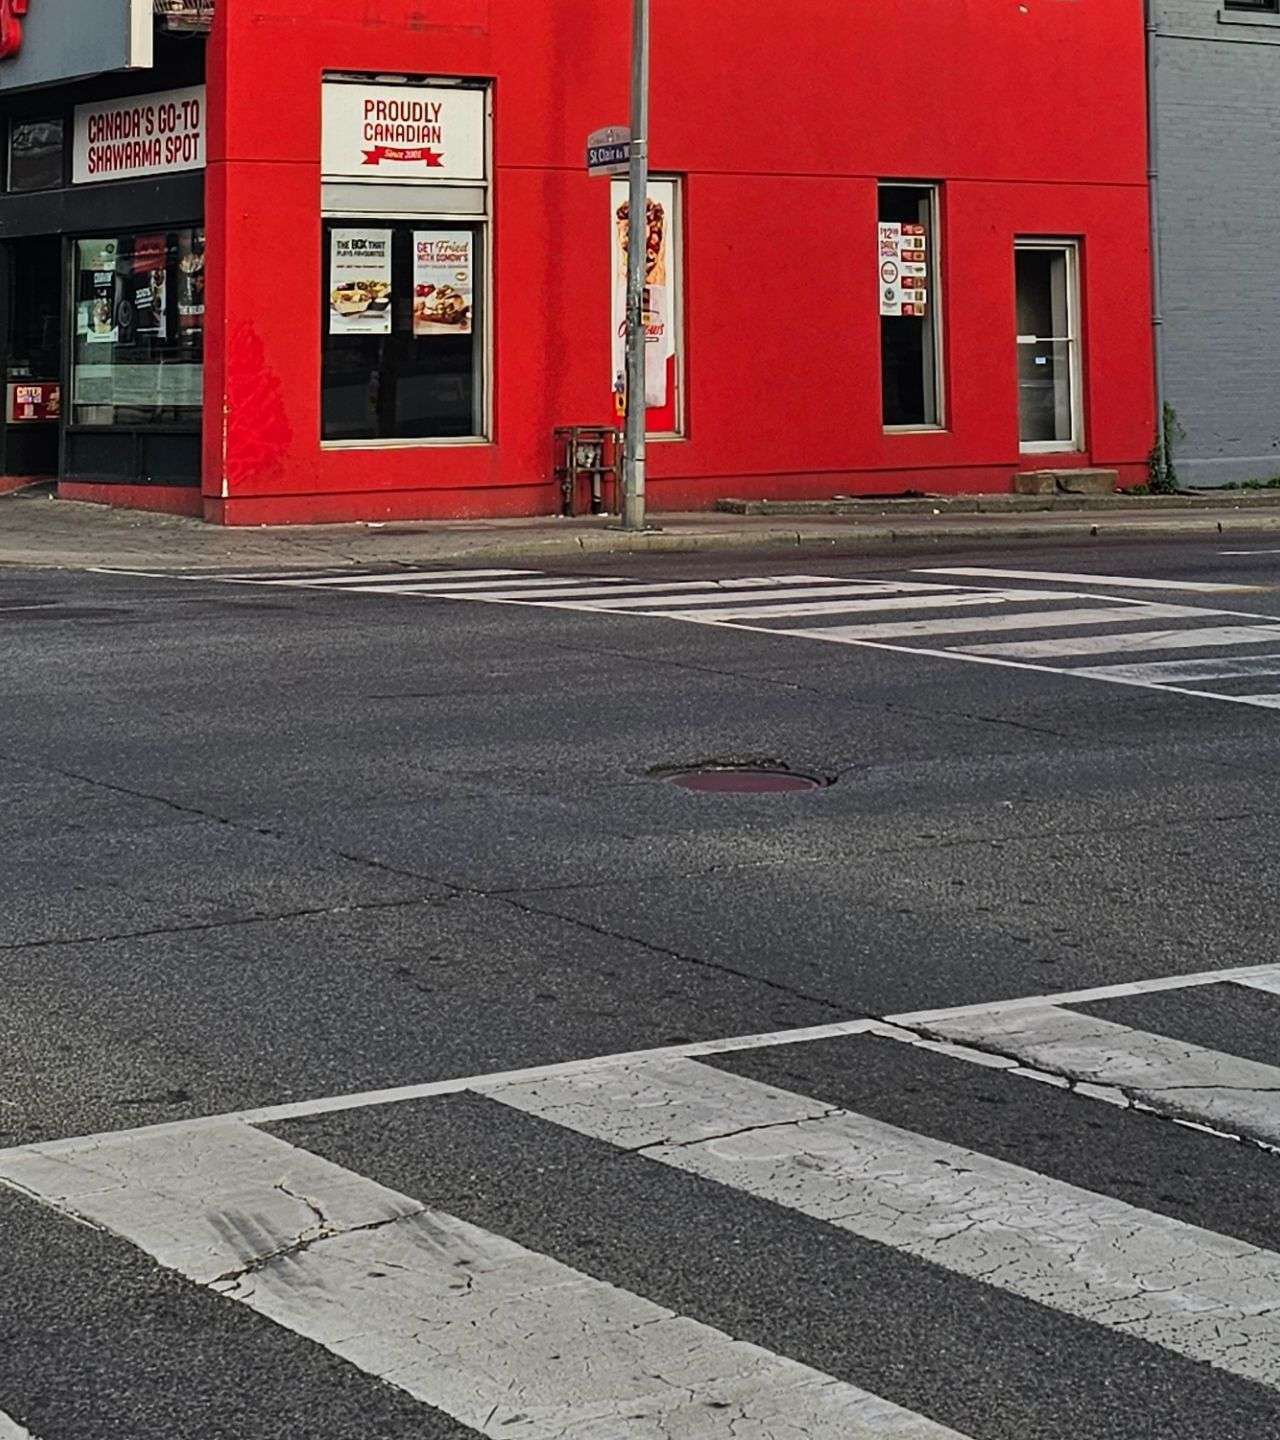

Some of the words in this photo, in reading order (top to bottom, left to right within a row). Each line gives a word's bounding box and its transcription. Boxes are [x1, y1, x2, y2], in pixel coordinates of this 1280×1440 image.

[364, 100, 442, 123] PROUDLY
[88, 106, 155, 143] CANADA'S
[158, 99, 200, 131] GO-TO
[364, 122, 442, 144] CANADIAN
[88, 142, 161, 174] SHAWARMA
[166, 133, 200, 164] SPOT
[384, 149, 403, 160] Since
[598, 148, 615, 162] Clair
[336, 240, 349, 250] THE
[351, 239, 368, 250] BOX
[369, 241, 386, 250] THAT
[417, 242, 432, 252] GET
[435, 240, 469, 254] Fried
[417, 254, 434, 262] WITH
